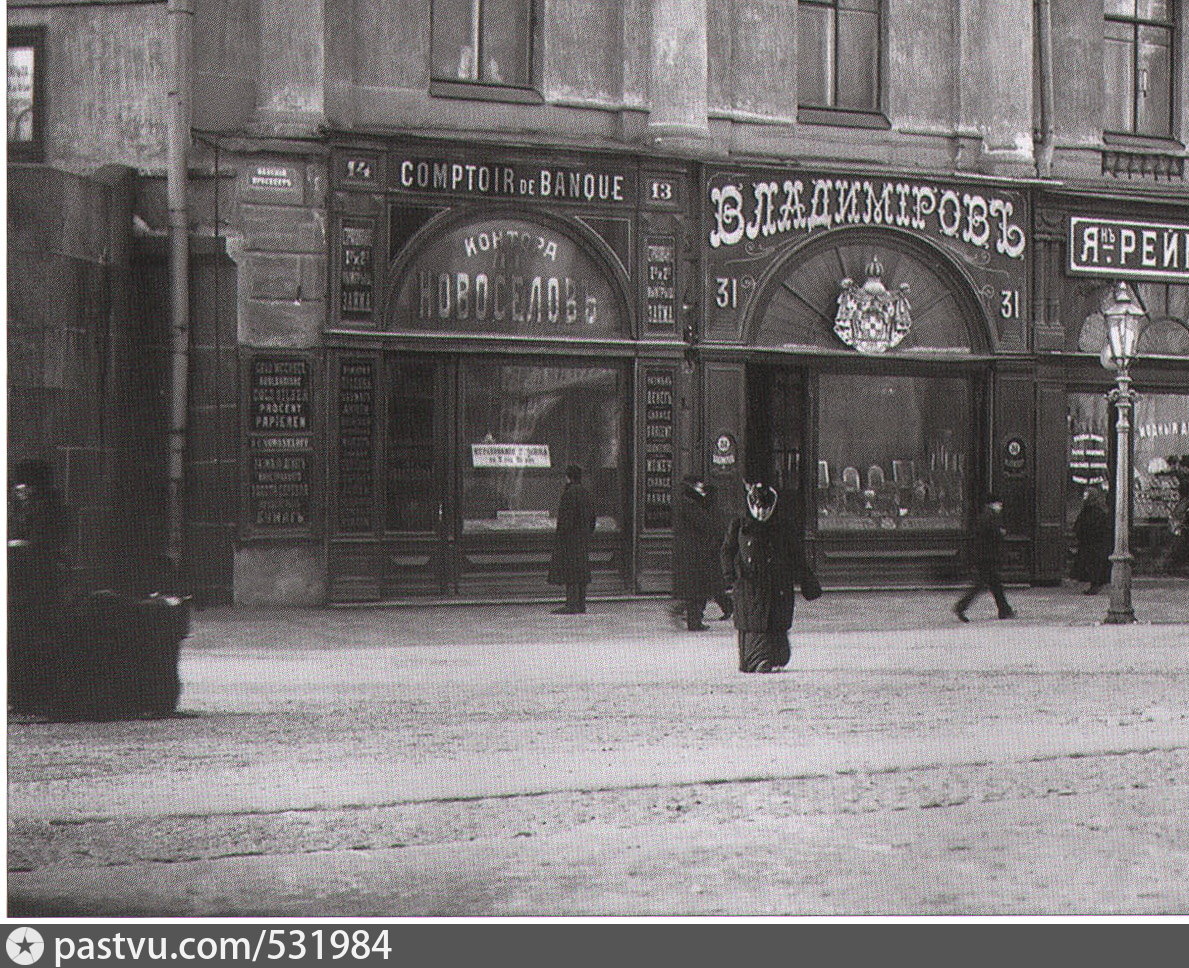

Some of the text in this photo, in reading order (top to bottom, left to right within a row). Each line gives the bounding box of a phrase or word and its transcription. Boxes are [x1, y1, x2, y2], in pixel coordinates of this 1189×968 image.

[401, 160, 624, 201] COMPTOIR DE BANQUE
[651, 182, 672, 200] 13
[710, 178, 1026, 260] ВЛАДИМIРОВЪ
[464, 230, 559, 262] КОНТОРА
[419, 271, 597, 324] НОВОСЕЛОВЪ
[716, 278, 737, 308] 31
[1000, 289, 1019, 319] 31
